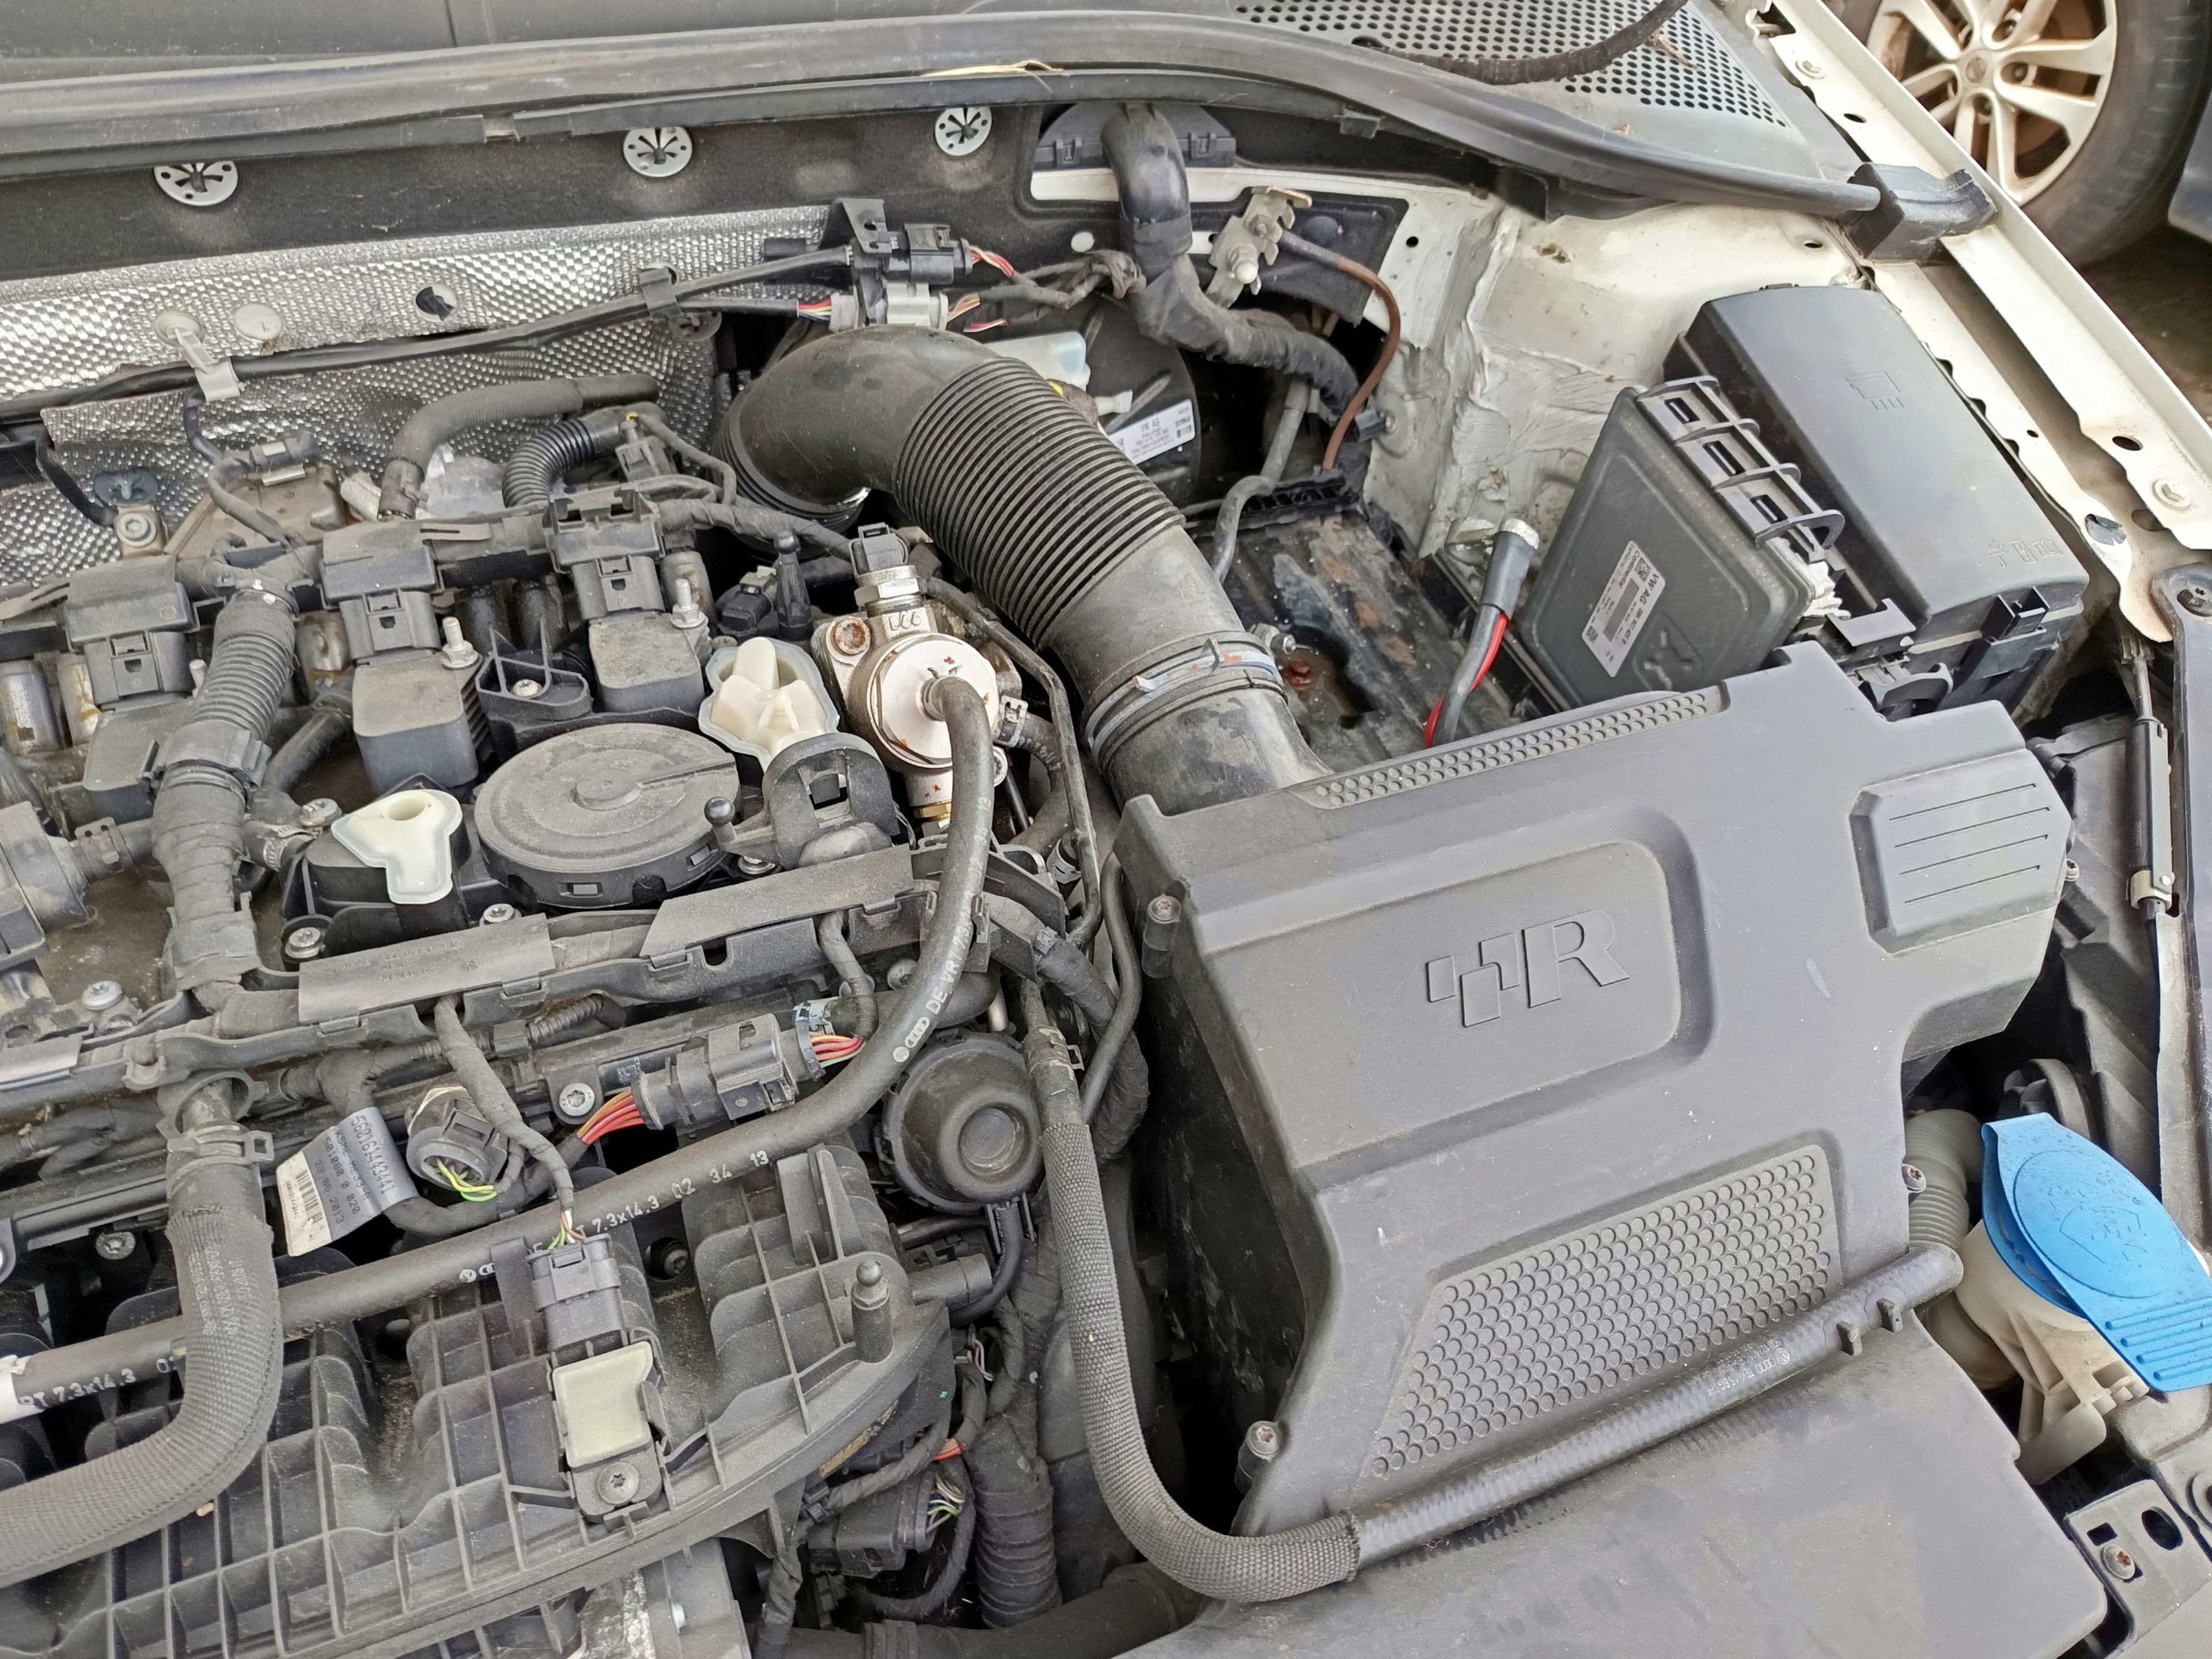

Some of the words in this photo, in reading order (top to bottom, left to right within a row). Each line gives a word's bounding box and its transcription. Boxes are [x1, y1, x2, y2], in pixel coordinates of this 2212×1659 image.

[1618, 550, 1640, 589] Continental
[1647, 573, 1658, 590] VW
[1639, 588, 1650, 605] AG
[926, 987, 948, 1014] DE
[592, 1195, 660, 1234] 7.3x14.3
[672, 1177, 696, 1199] 02
[709, 1164, 732, 1183] 34
[750, 1150, 769, 1166] 13
[52, 1368, 136, 1402] 7.3x14.3
